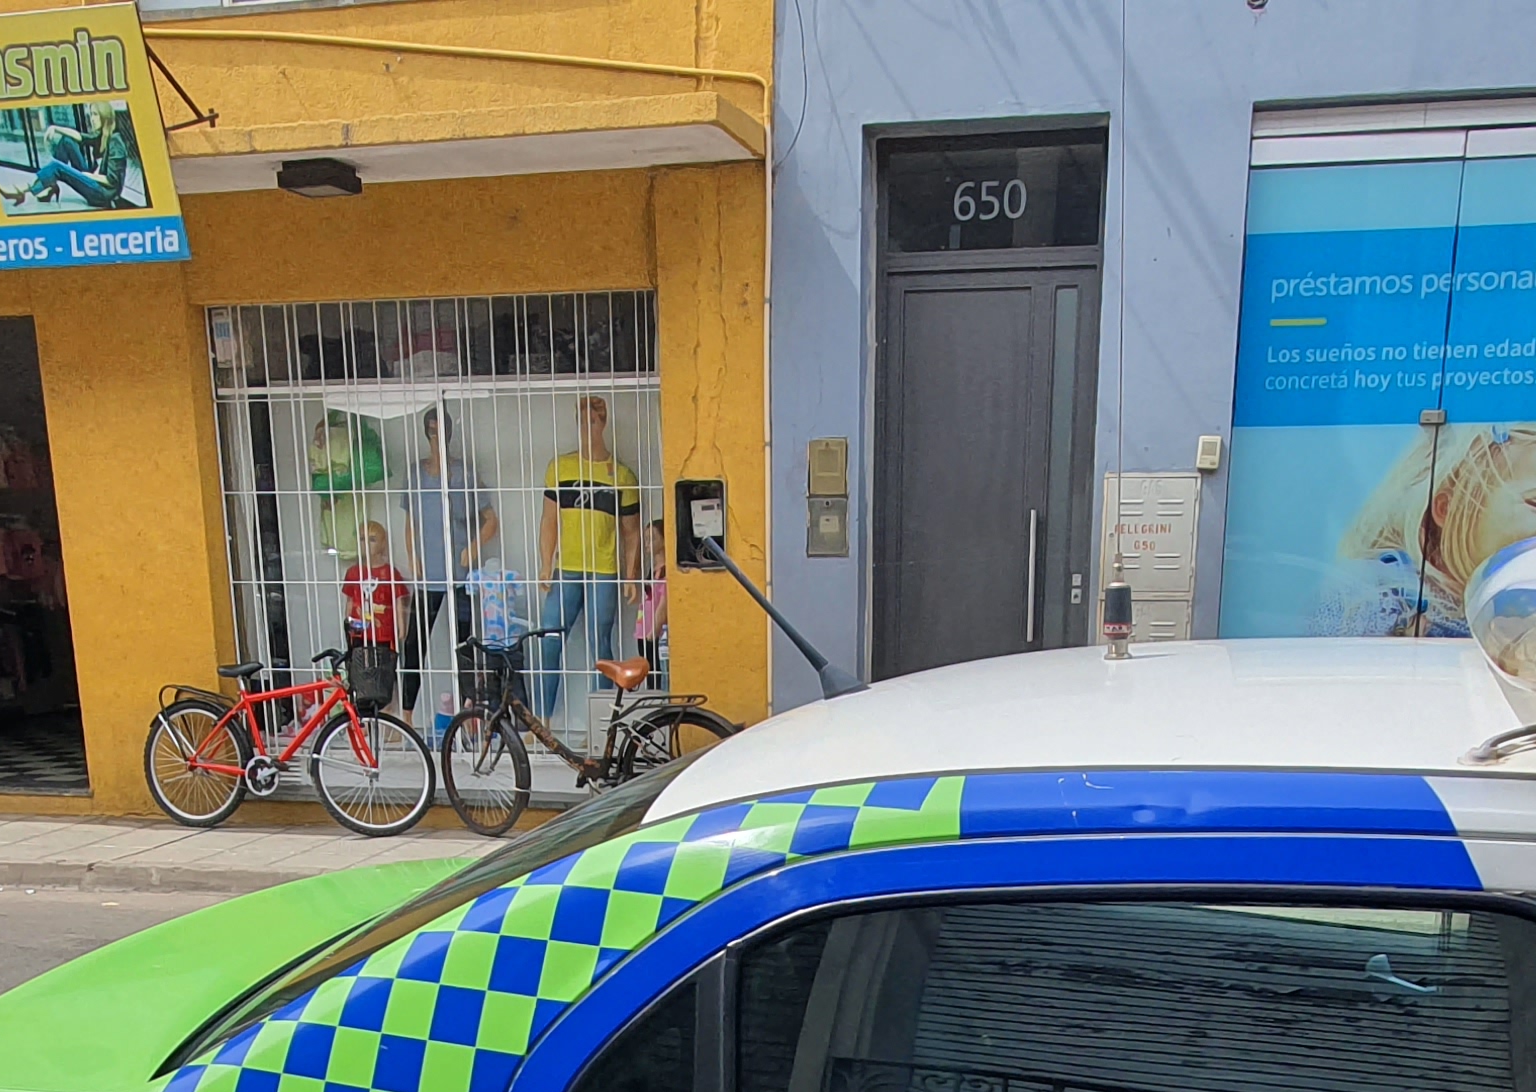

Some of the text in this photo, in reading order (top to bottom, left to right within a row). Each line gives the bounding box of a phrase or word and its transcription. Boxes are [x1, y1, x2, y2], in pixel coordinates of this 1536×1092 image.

[953, 179, 1027, 221] 650
[70, 226, 179, 258] Lencería
[1271, 271, 1414, 304] préstamos
[1267, 345, 1300, 363] Los
[1305, 343, 1376, 363] sueños
[1381, 345, 1407, 361] no
[1413, 341, 1478, 361] tienen
[1265, 368, 1349, 390] concretá
[1354, 370, 1392, 393] hoy
[1396, 371, 1427, 388] tus
